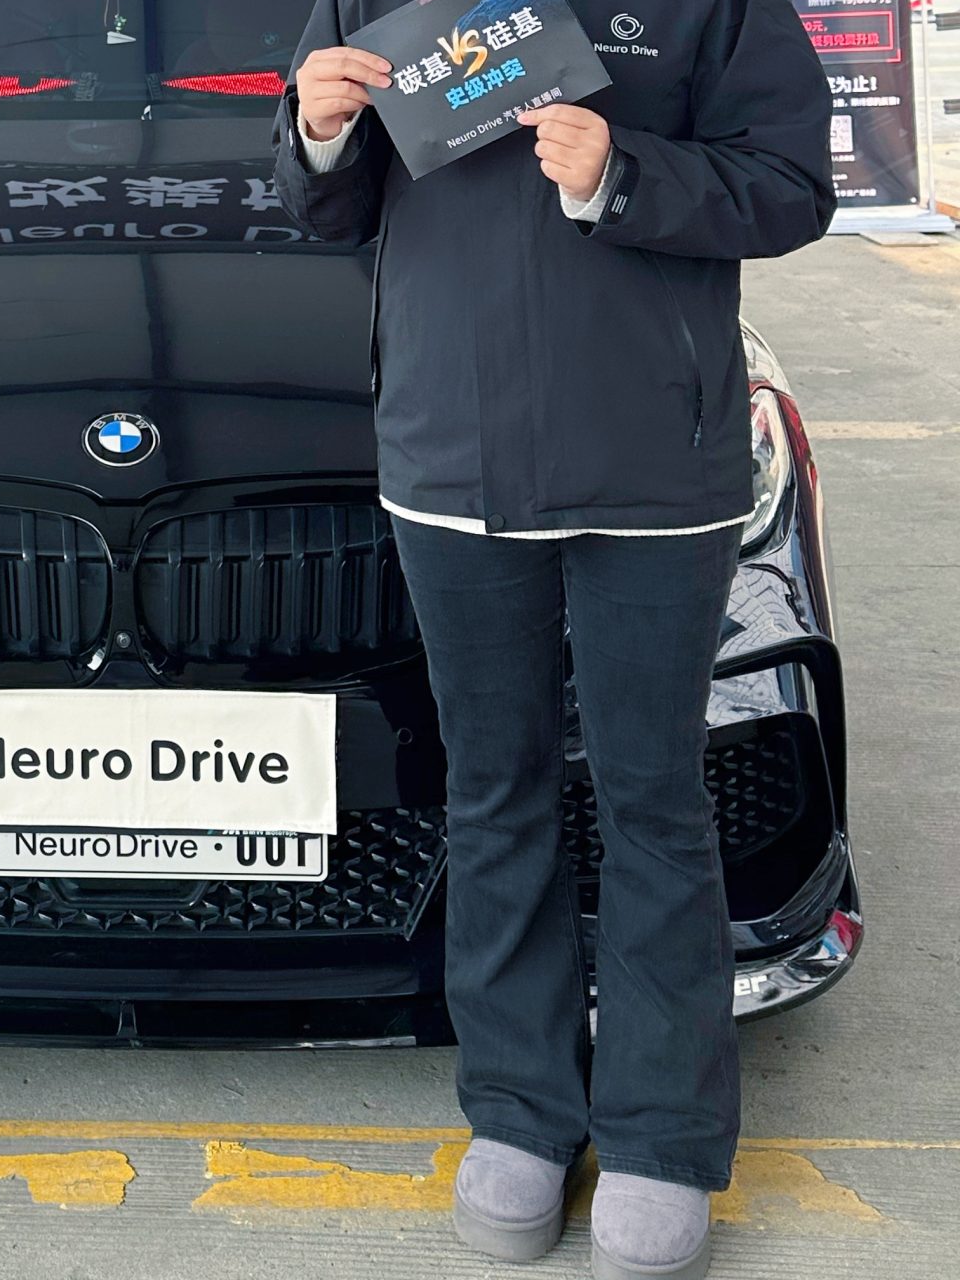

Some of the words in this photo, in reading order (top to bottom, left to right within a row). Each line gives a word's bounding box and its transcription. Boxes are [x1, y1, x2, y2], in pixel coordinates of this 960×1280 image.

[594, 42, 628, 54] Neuro
[631, 44, 659, 57] Drive
[444, 56, 528, 111] 史级冲突
[446, 129, 477, 149] Neuro
[476, 116, 503, 135] Drive
[502, 87, 563, 122] 汽车人直播间
[92, 413, 149, 430] BMW
[150, 738, 290, 785] Drive
[735, 974, 768, 997] er
